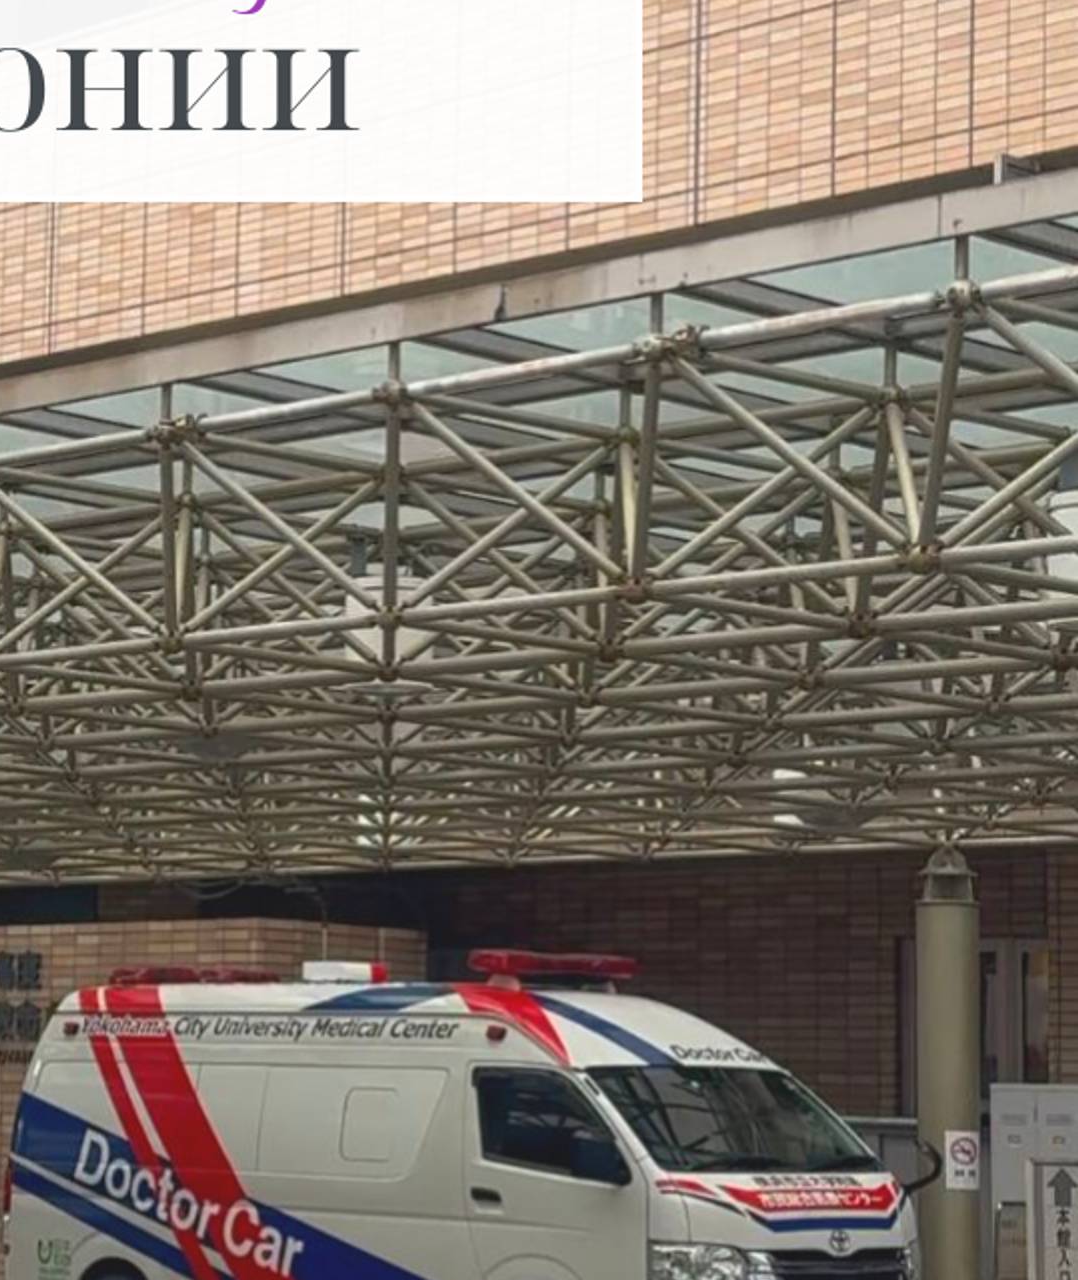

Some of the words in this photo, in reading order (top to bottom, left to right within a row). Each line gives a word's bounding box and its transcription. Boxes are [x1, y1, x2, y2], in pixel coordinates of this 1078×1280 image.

[82, 1014, 169, 1035] Yokohama
[174, 1015, 212, 1040] City
[213, 1017, 308, 1043] University
[310, 1017, 386, 1039] Medical
[389, 1019, 460, 1040] Center
